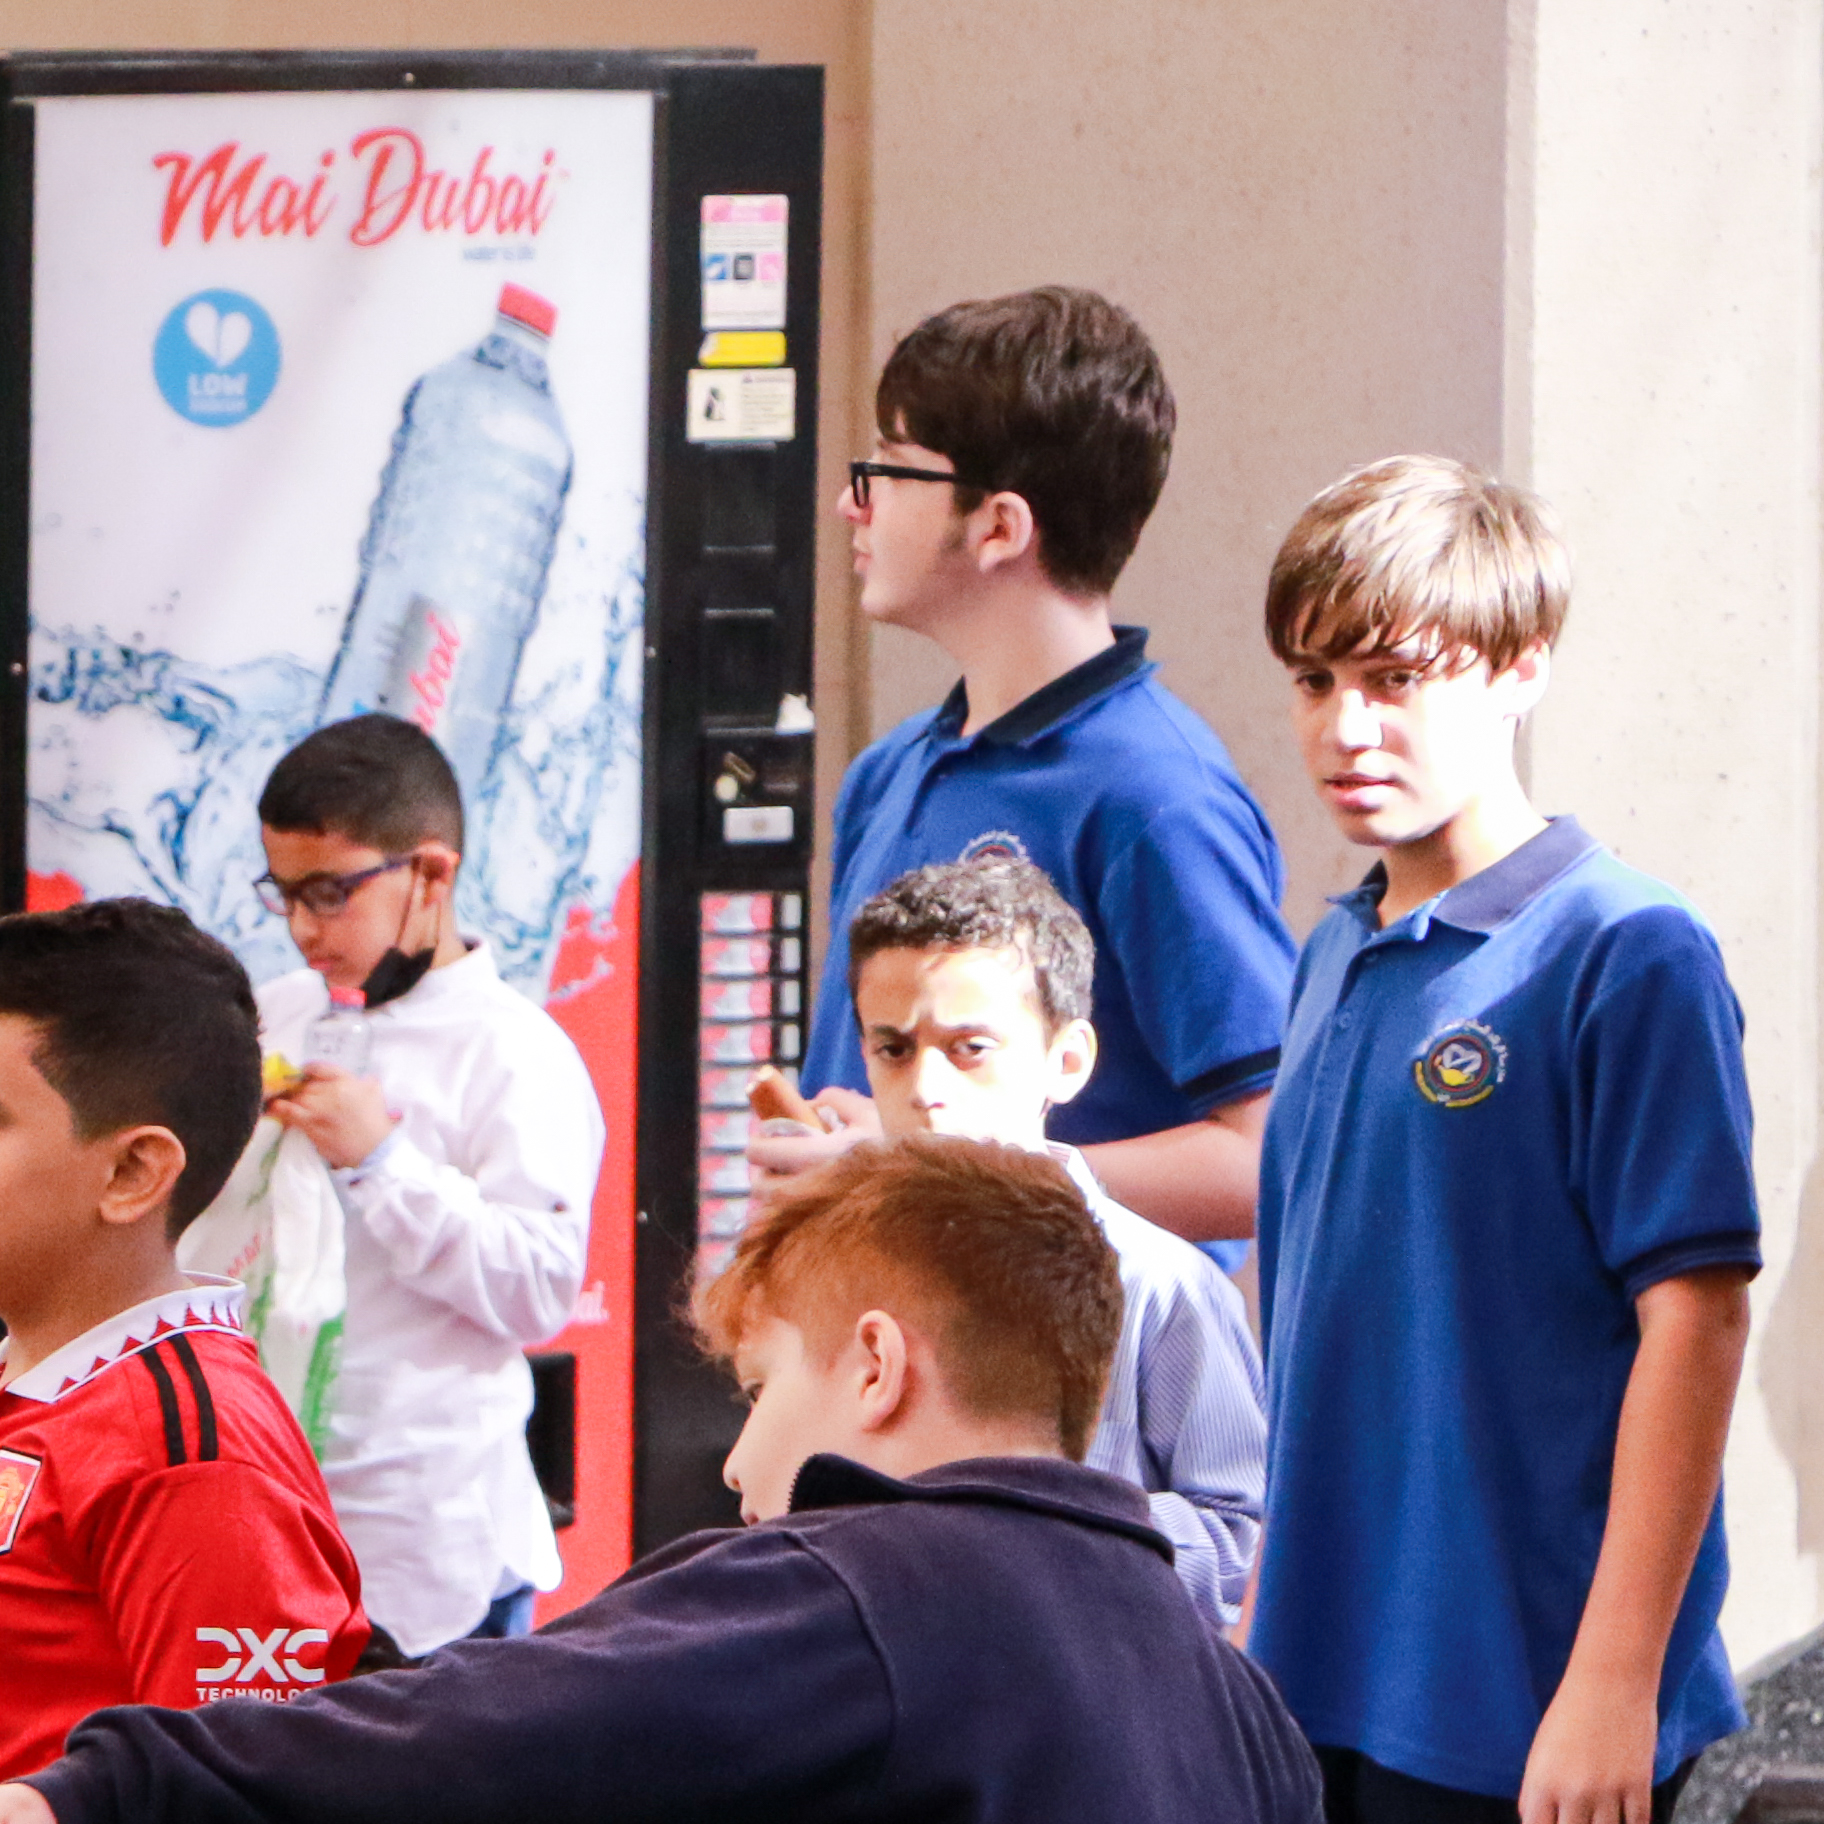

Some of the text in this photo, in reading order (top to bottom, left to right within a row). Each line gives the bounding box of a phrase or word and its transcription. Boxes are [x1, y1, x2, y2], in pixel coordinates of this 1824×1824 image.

[153, 126, 556, 247] Mai Dubai
[188, 372, 249, 396] LOW
[195, 1627, 329, 1682] DXC
